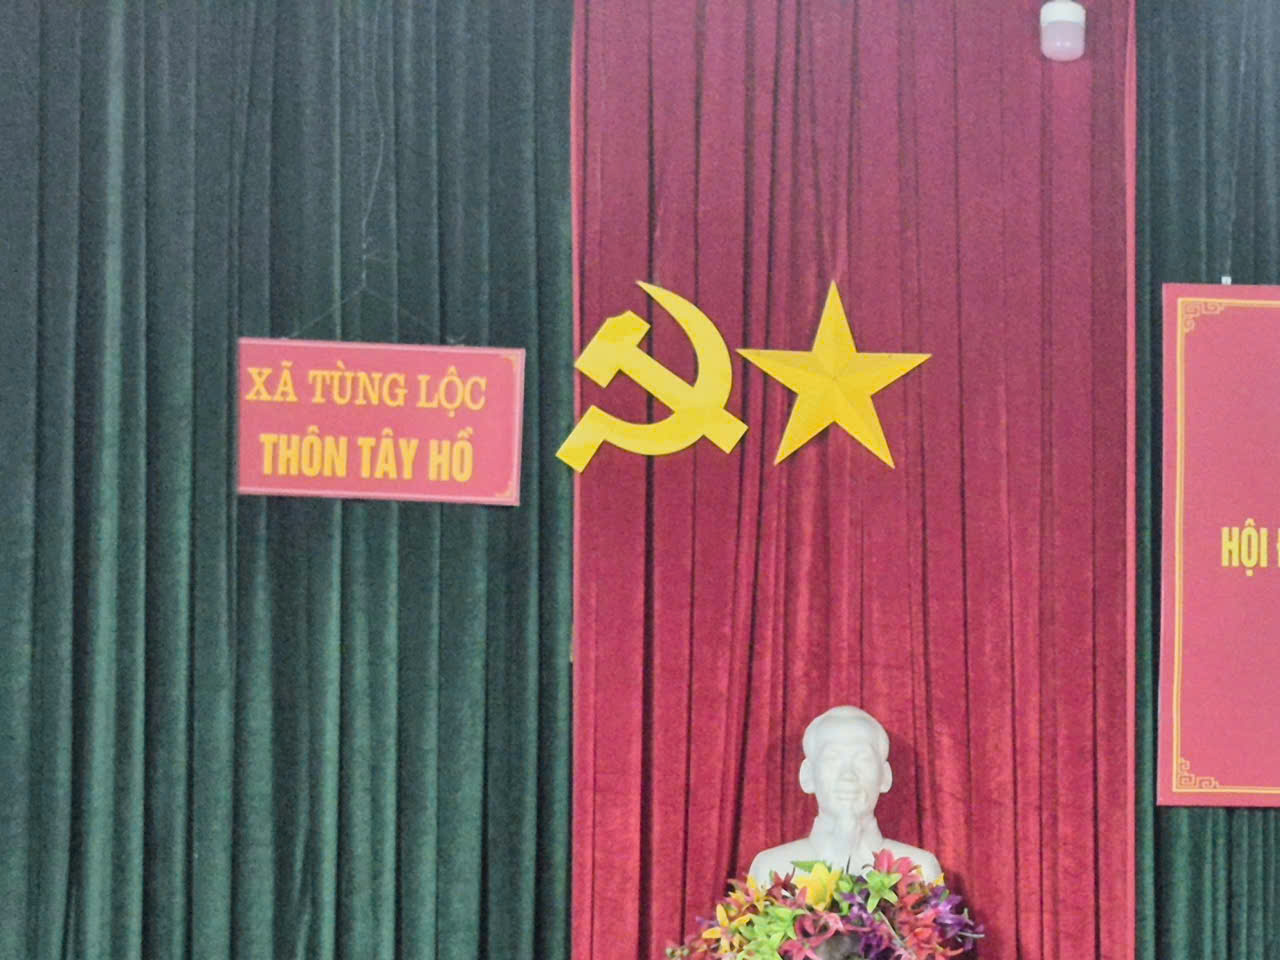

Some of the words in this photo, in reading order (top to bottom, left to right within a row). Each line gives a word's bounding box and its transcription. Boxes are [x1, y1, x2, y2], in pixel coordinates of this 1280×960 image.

[246, 360, 297, 402] XÃ
[308, 360, 408, 407] TÙNG
[416, 365, 487, 417] LỘC
[259, 424, 347, 478] THÔN
[358, 427, 419, 480] TÂY
[428, 427, 474, 483] HỒ
[1221, 518, 1268, 577] HỘI
